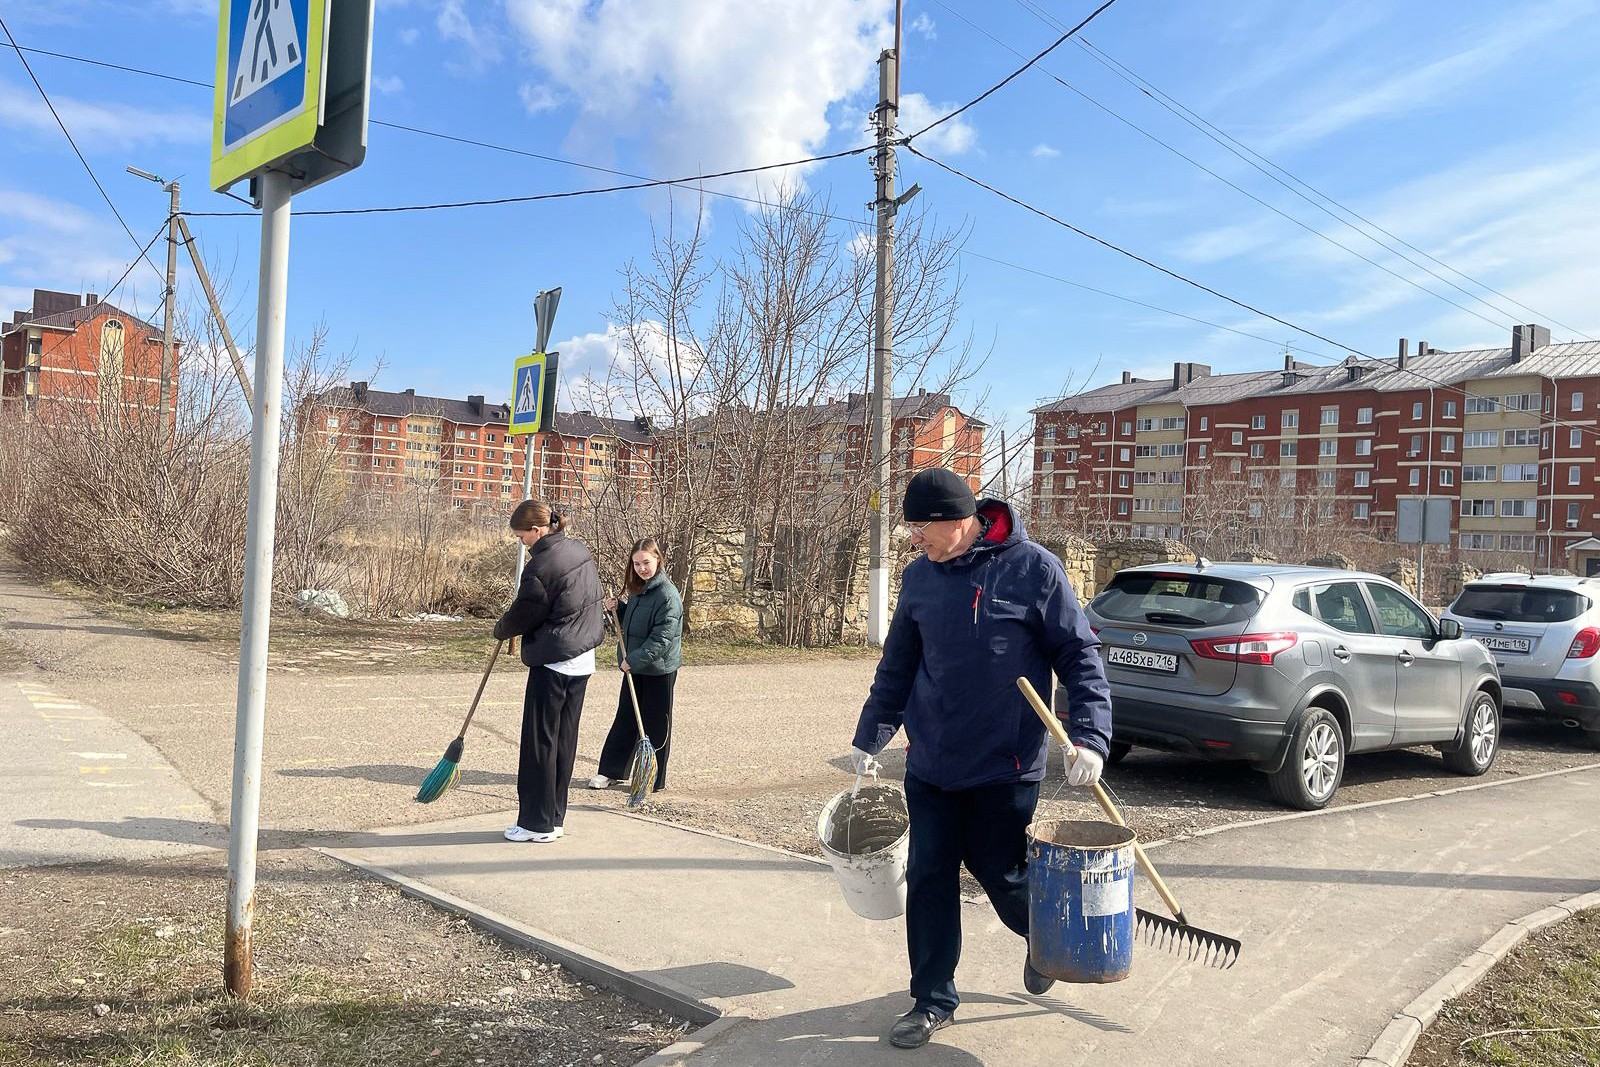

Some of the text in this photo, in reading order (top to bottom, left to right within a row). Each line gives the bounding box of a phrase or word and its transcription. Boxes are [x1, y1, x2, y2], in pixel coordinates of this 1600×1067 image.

[1480, 637, 1526, 649] 191МЕ 116
[1156, 654, 1173, 666] 716
